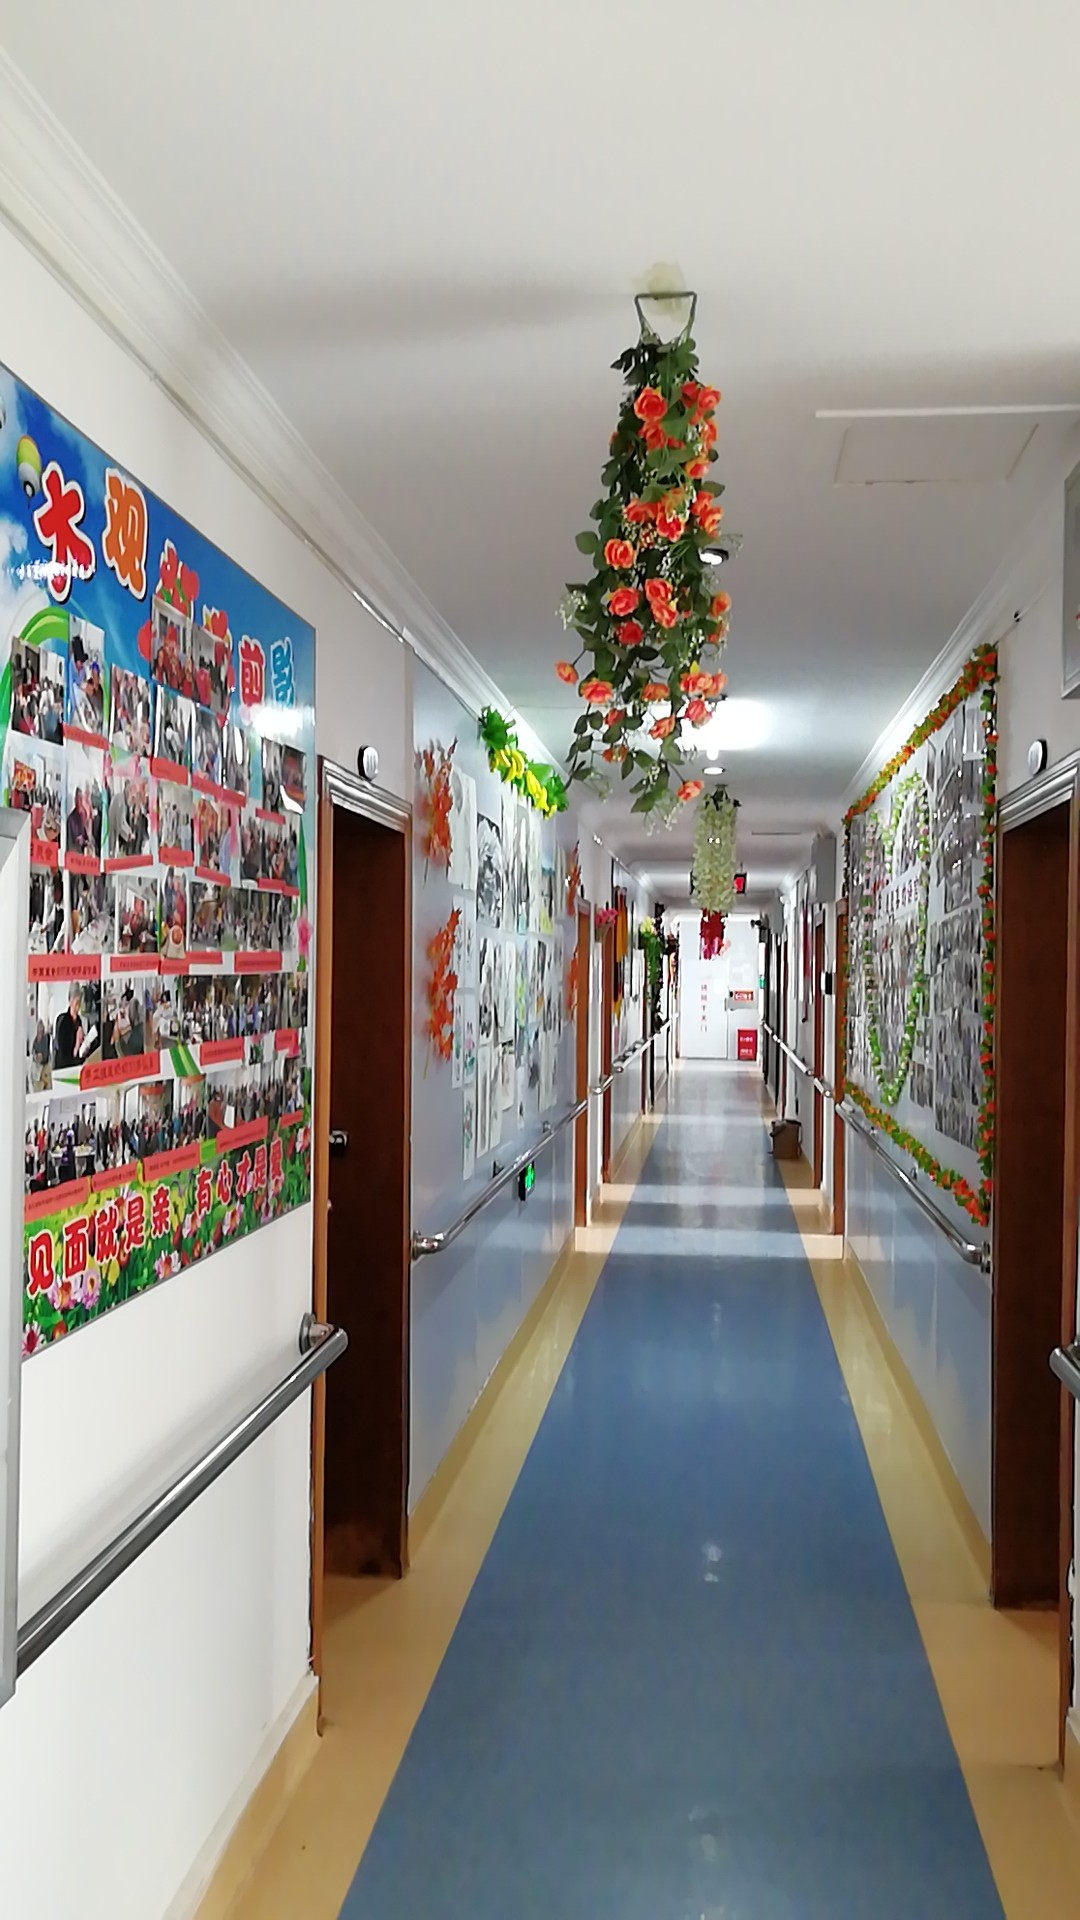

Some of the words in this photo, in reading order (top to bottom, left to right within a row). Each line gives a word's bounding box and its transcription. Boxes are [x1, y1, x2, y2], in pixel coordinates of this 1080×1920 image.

[27, 1184, 171, 1297] 见面就是亲
